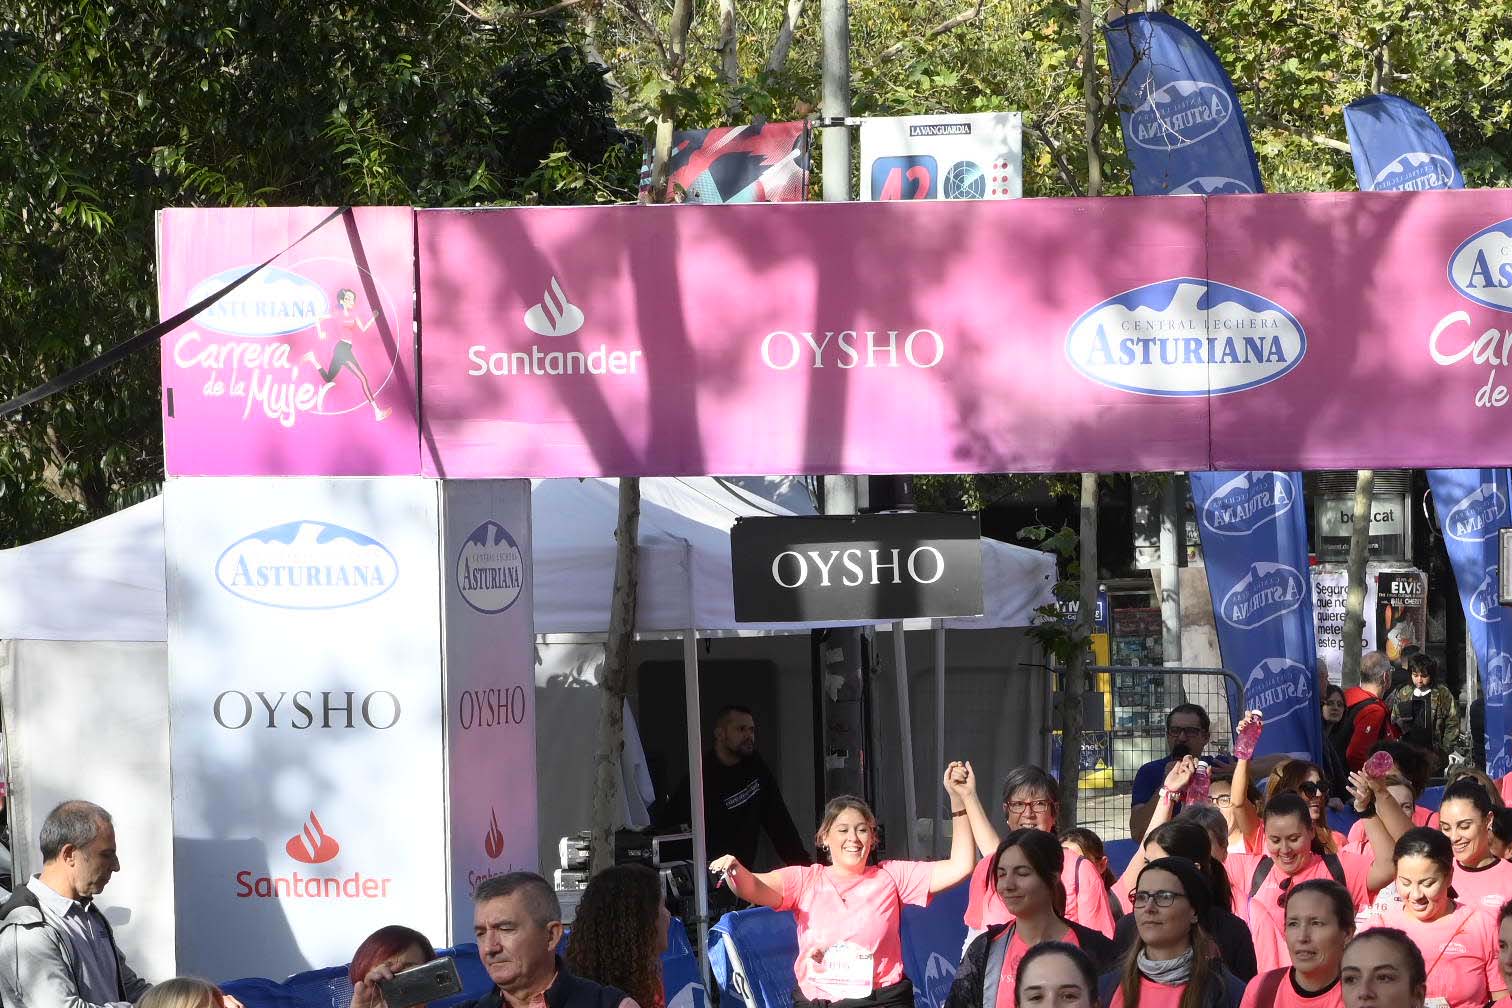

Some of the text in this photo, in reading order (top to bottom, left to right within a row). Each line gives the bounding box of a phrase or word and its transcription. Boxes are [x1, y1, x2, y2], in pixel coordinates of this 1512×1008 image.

[1121, 318, 1281, 331] CENTRAL LECHERA
[174, 333, 290, 369] Carrera
[469, 345, 641, 375] Santander
[761, 328, 944, 370] OYSHO
[1085, 323, 1288, 366] ASTURIANA
[203, 364, 335, 427] de la Mujer
[1475, 376, 1508, 408] de
[231, 551, 384, 588] ASTURIANA
[463, 563, 520, 592] ASTURIANA
[772, 546, 945, 589] OYSHO
[1316, 600, 1333, 609] que
[1391, 582, 1421, 594] ELVIS
[1318, 639, 1337, 649] este
[213, 690, 402, 730] OYSHO
[459, 685, 526, 730] OYSHO
[237, 871, 392, 899] Santander
